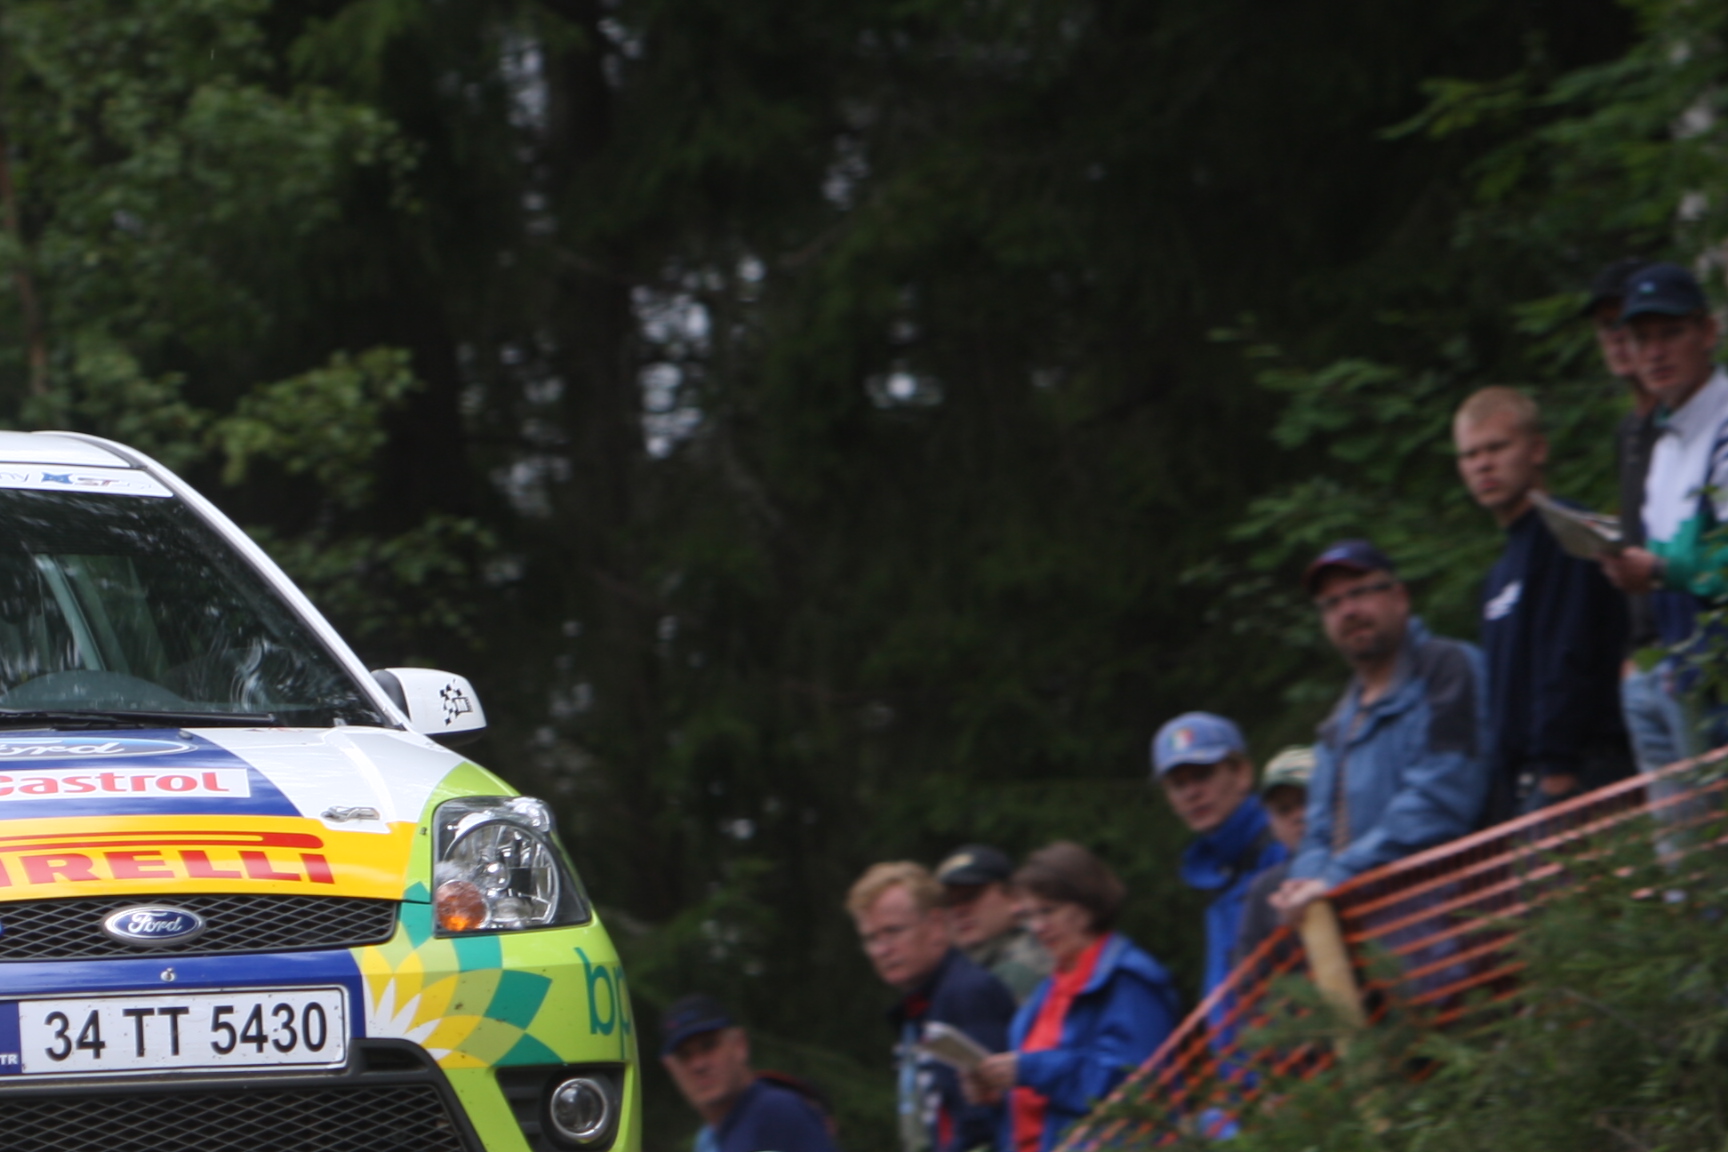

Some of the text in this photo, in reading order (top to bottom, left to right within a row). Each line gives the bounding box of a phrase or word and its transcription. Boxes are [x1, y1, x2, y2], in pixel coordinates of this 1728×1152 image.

[127, 908, 184, 935] Ford
[43, 1001, 328, 1062] 34 TT 5430
[573, 946, 631, 1060] bp
